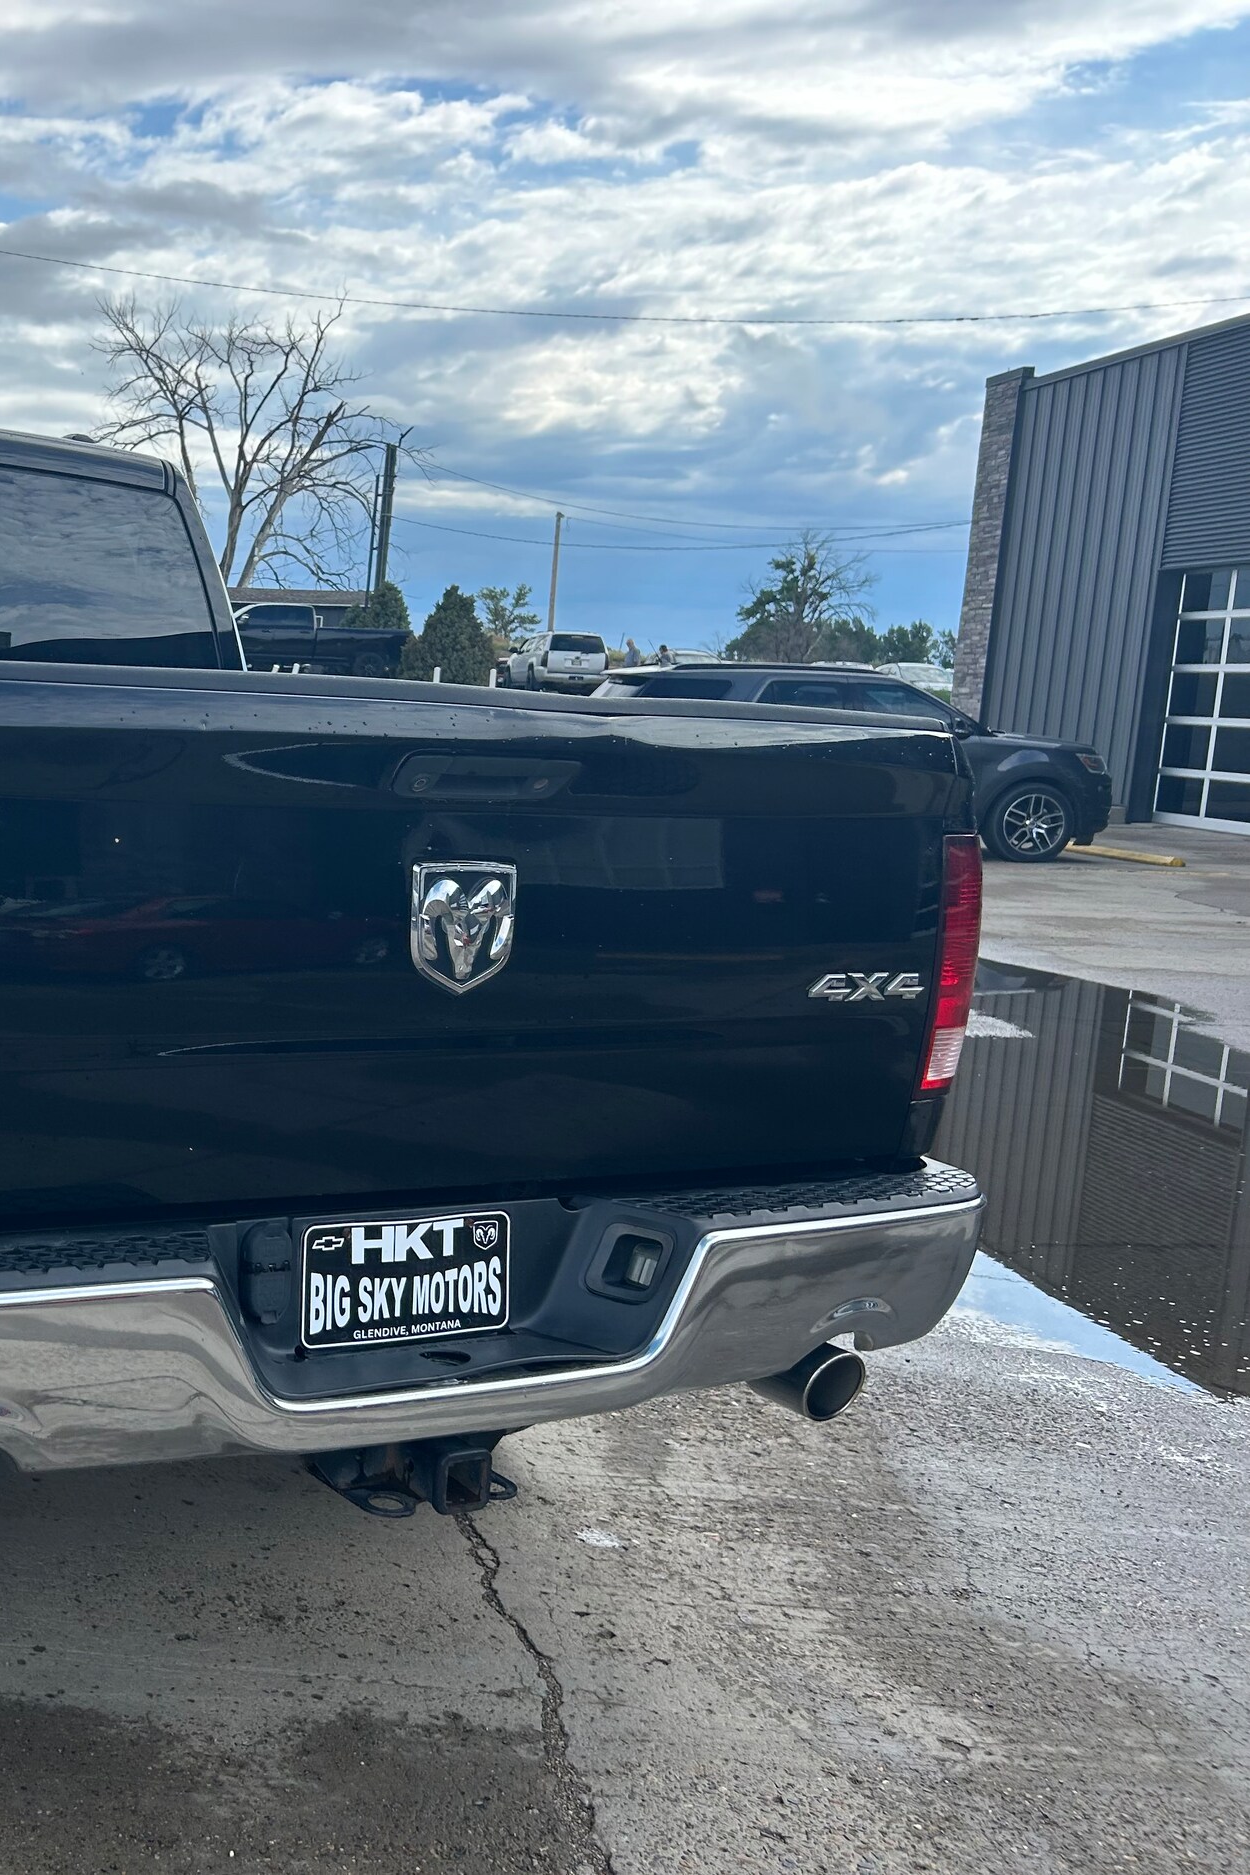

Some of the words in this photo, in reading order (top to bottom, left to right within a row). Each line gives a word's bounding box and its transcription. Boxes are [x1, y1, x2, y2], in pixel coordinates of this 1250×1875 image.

[351, 1218, 465, 1265] HKT
[309, 1272, 351, 1336] BIG
[357, 1276, 407, 1324] SKY
[412, 1255, 502, 1317] MOTORS
[353, 1325, 410, 1340] GLENDIVE,
[411, 1318, 462, 1335] MONTANA
